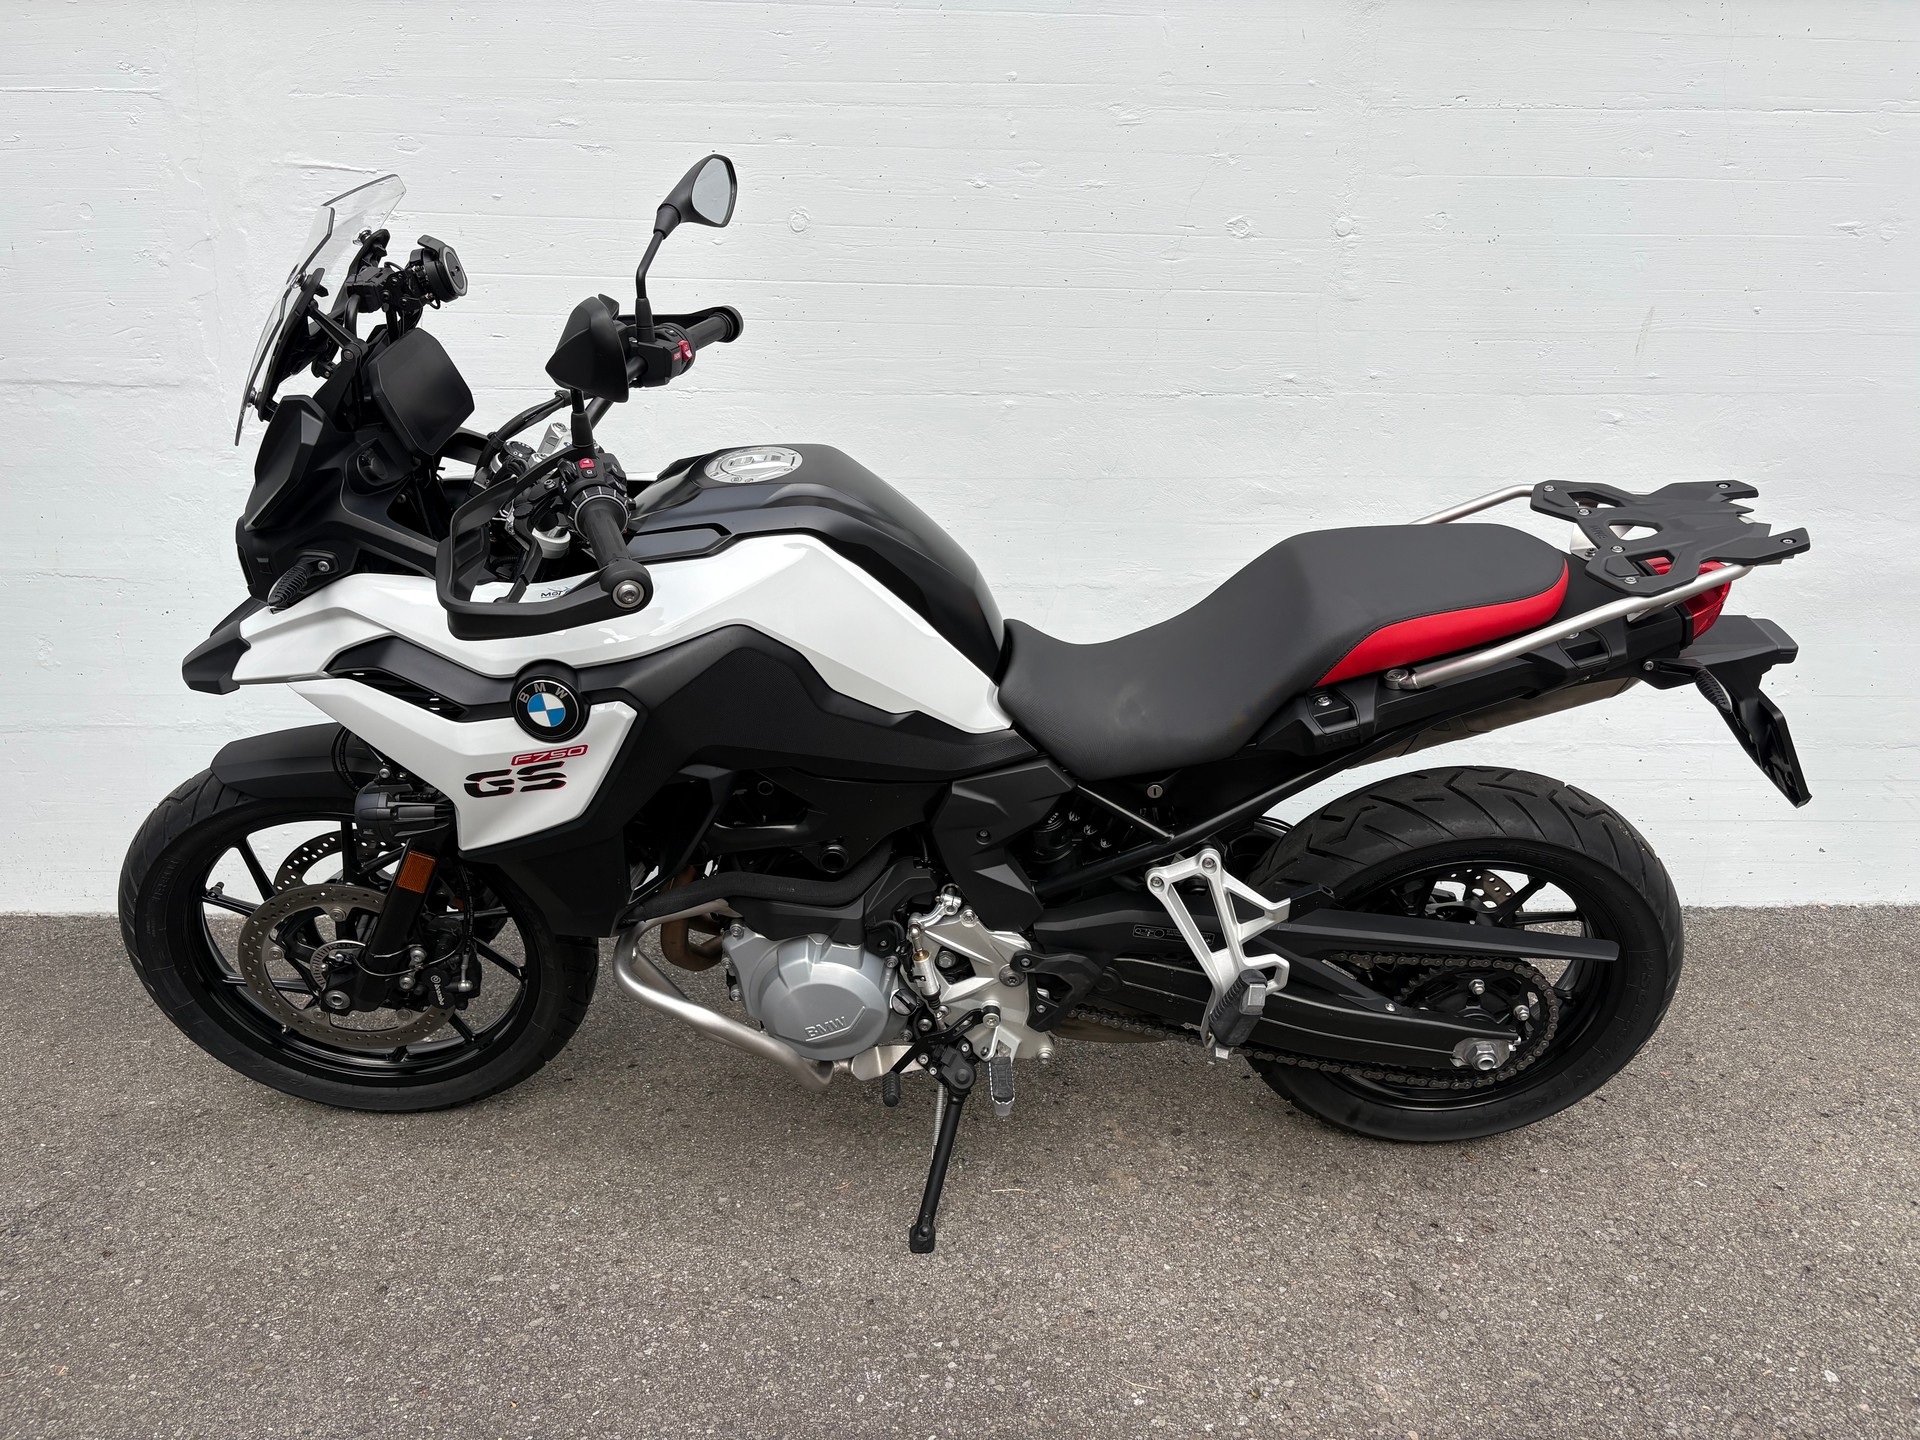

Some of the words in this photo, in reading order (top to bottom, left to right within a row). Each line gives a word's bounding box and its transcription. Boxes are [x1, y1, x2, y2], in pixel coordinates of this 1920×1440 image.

[518, 682, 569, 704] BMW
[514, 746, 585, 765] F750
[463, 760, 567, 798] GS
[804, 1015, 847, 1038] BMW
